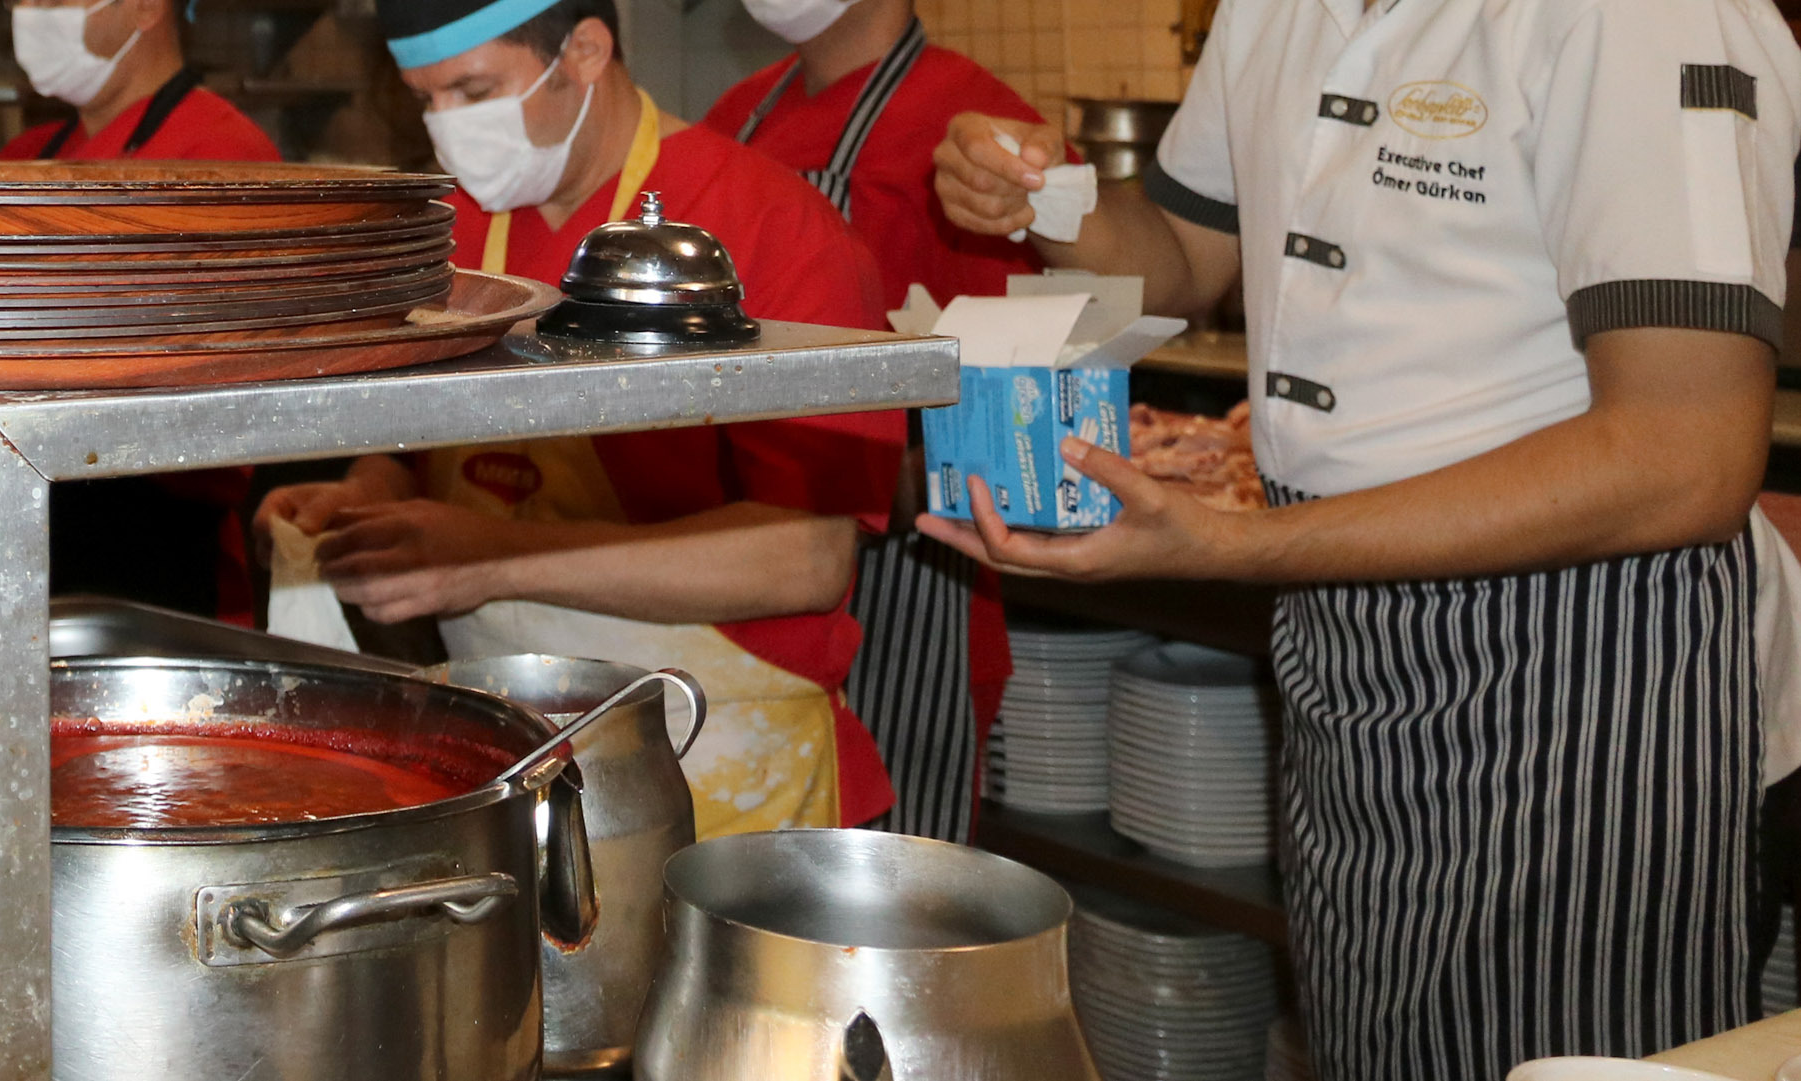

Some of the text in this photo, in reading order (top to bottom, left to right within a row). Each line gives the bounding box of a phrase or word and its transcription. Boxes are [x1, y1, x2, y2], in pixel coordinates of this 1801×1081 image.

[1377, 146, 1486, 181] Executive Chef
[1372, 167, 1486, 204] Ömer Gürkan
